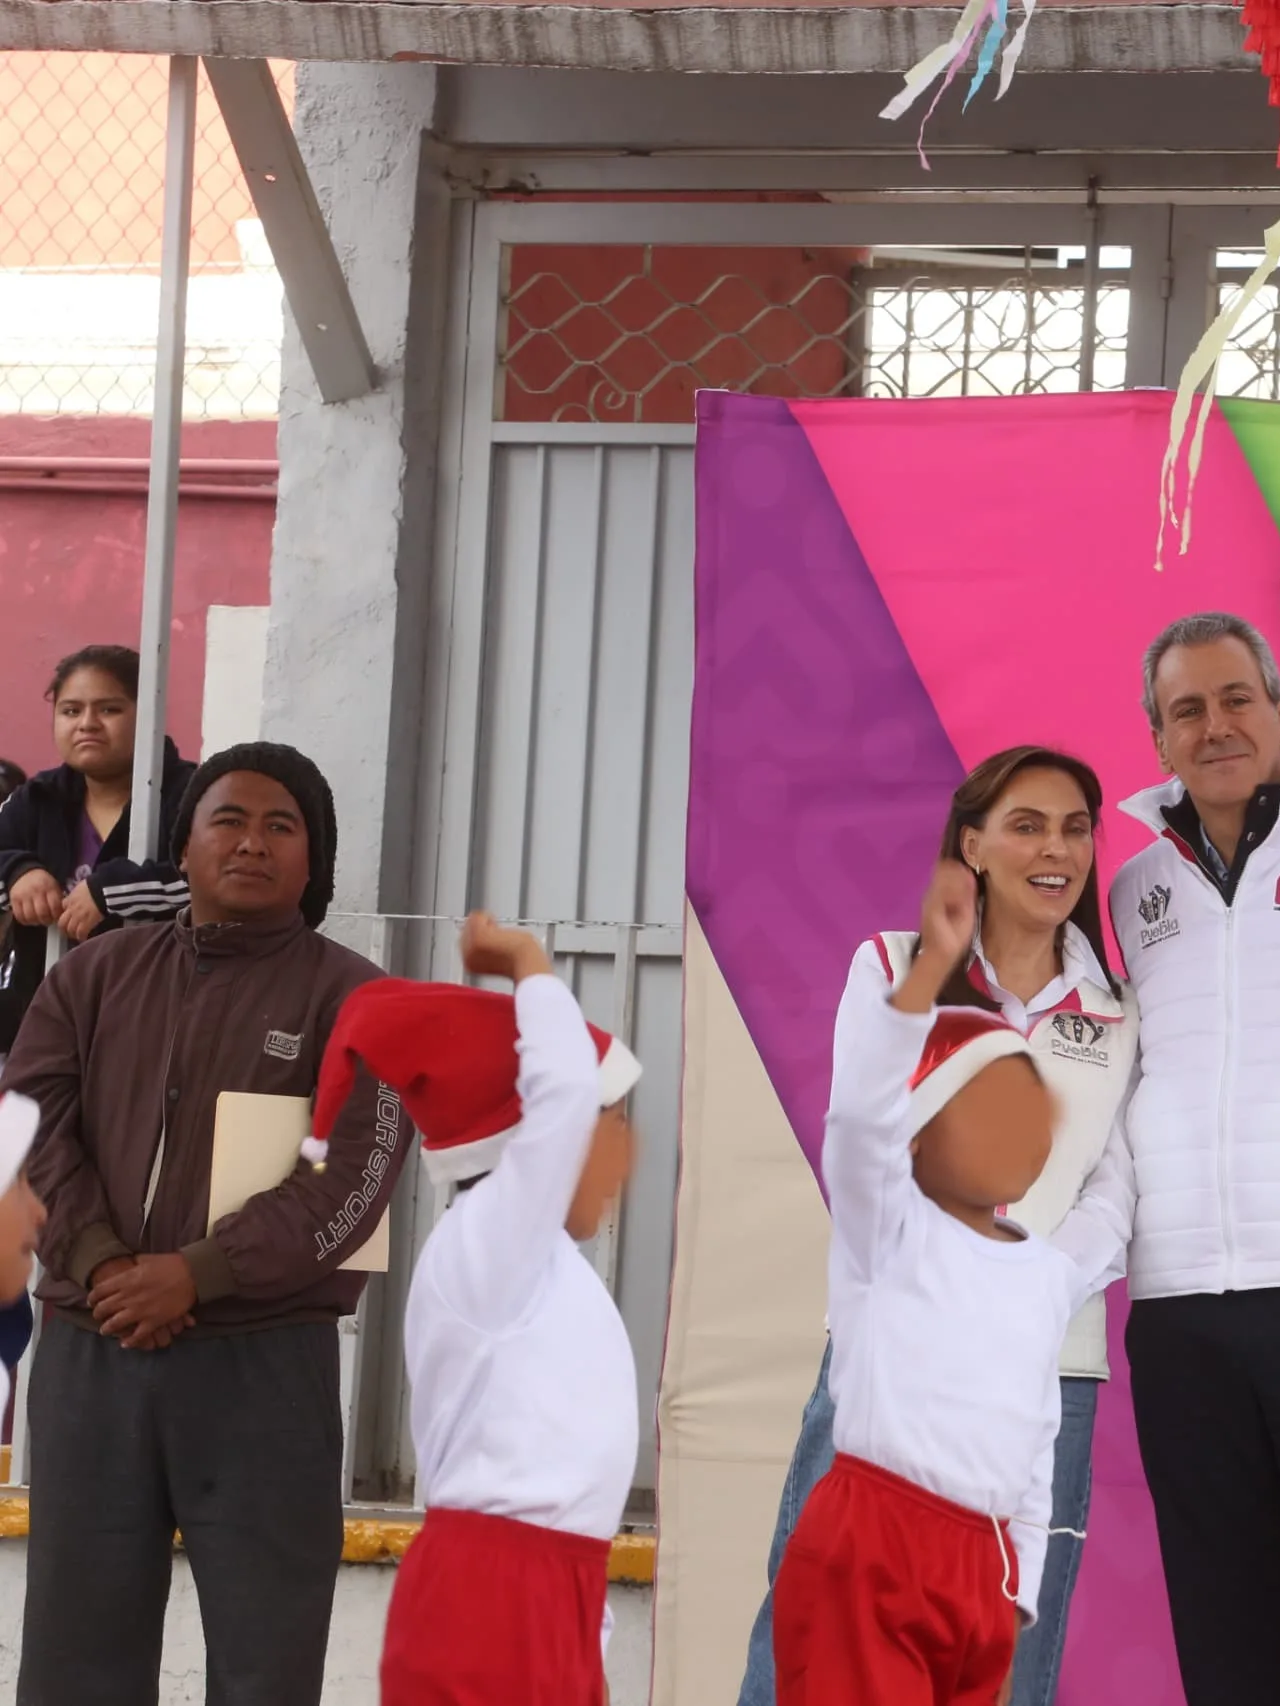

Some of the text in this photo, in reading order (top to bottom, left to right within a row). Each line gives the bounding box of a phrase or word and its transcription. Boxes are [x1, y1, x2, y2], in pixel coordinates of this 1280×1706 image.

[1140, 918, 1178, 944] Puebla
[1051, 1038, 1109, 1061] Puebla
[314, 1080, 401, 1261] IOR SPORT
